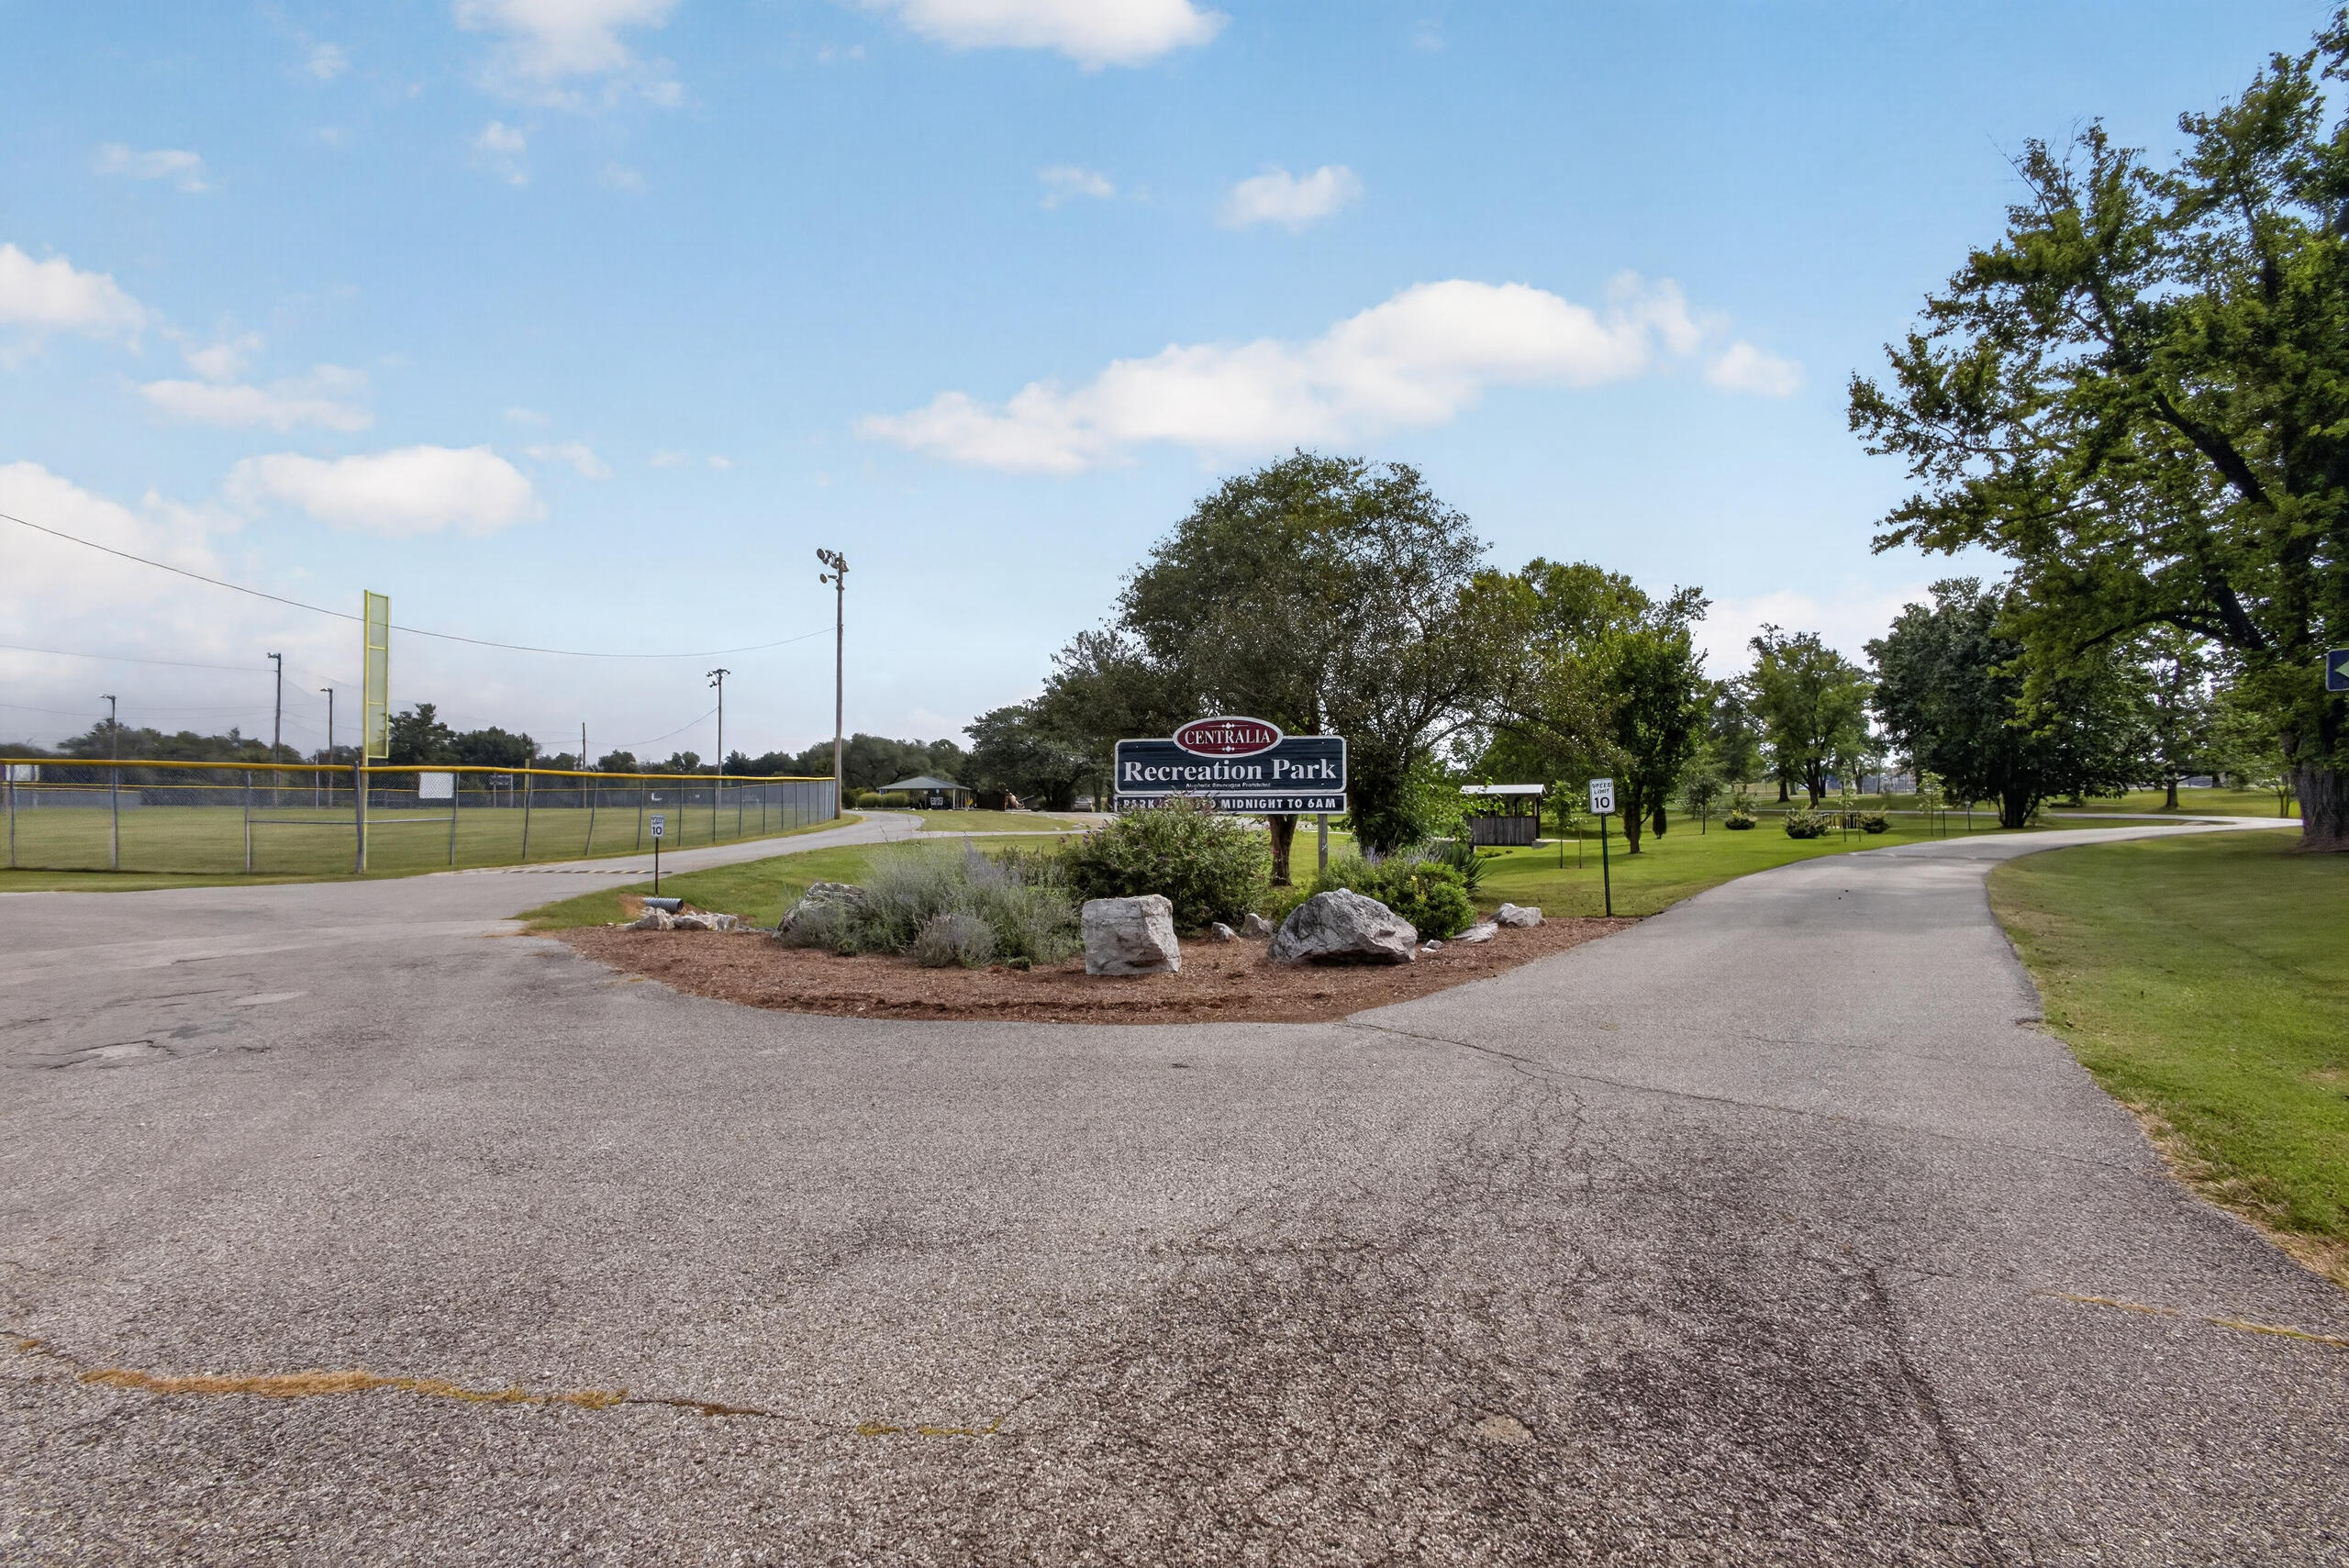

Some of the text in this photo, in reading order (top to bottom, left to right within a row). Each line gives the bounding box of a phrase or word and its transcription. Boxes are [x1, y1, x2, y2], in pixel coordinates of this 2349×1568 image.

[1185, 728, 1272, 745] CENTRALIA
[1123, 759, 1337, 782] Recreation Park
[1123, 799, 1154, 809] PARK
[1220, 798, 1284, 809] MIDNIGHT
[1286, 798, 1303, 809] TO
[1308, 798, 1337, 808] 6AM
[1594, 796, 1610, 808] 10
[652, 827, 662, 835] 10
